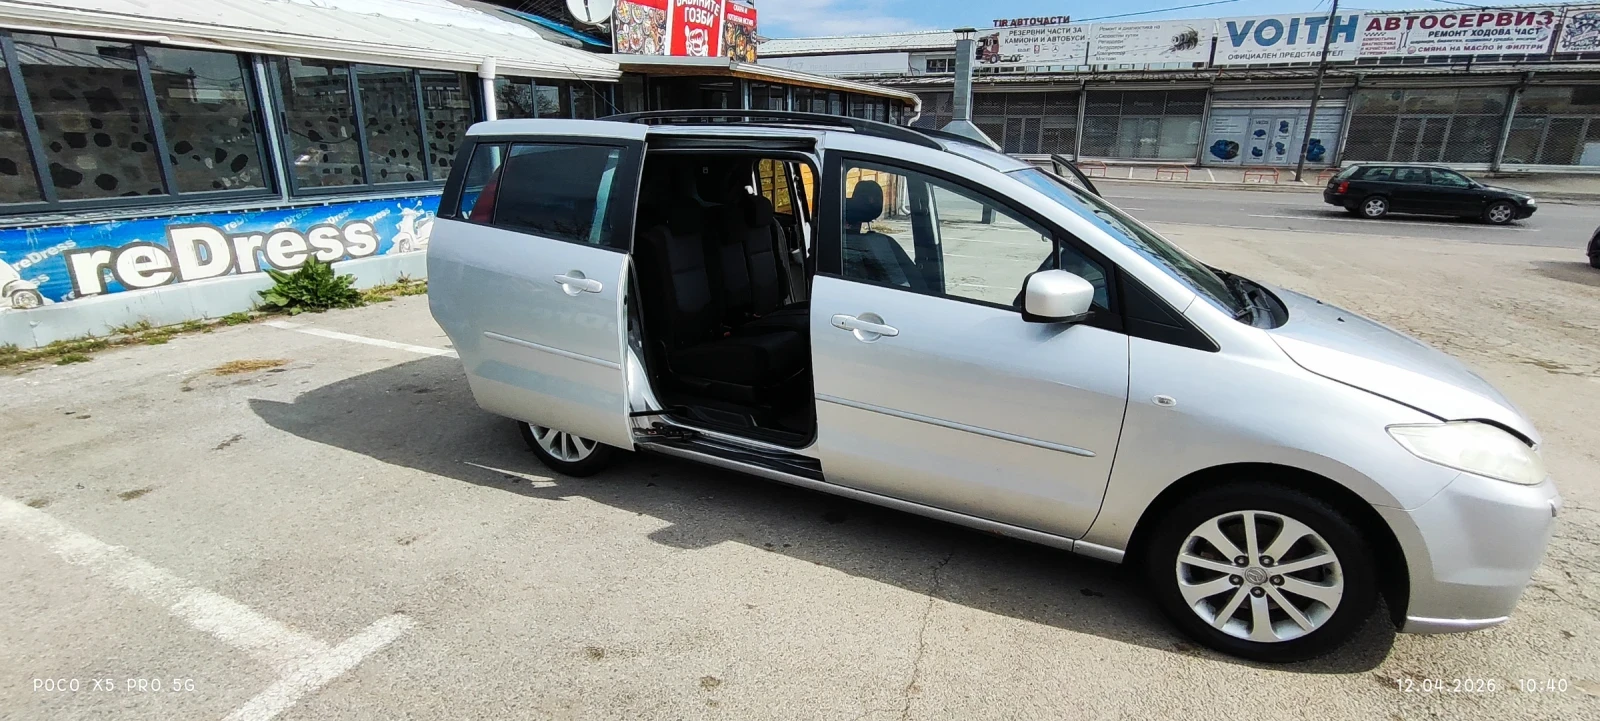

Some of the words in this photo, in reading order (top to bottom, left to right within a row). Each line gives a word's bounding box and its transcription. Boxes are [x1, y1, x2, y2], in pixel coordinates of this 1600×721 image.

[684, 7, 714, 27] ГОЗБИ
[1010, 16, 1070, 27] АВТОЧАСТИ
[1365, 11, 1554, 31] АВТОСЕРВИЗ
[1009, 28, 1046, 36] РЕЗЕРВНИ
[1226, 15, 1359, 47] VOITH
[1470, 28, 1511, 37] ХОДОВА
[1514, 27, 1542, 35] ЧАСТ
[1228, 52, 1277, 60] ОФИЦИАЛЕН
[1280, 50, 1344, 58] ПРЕДСТАВТЕЛ
[323, 207, 354, 225] Dress
[12, 239, 77, 271] reDress
[68, 221, 379, 297] reDress
